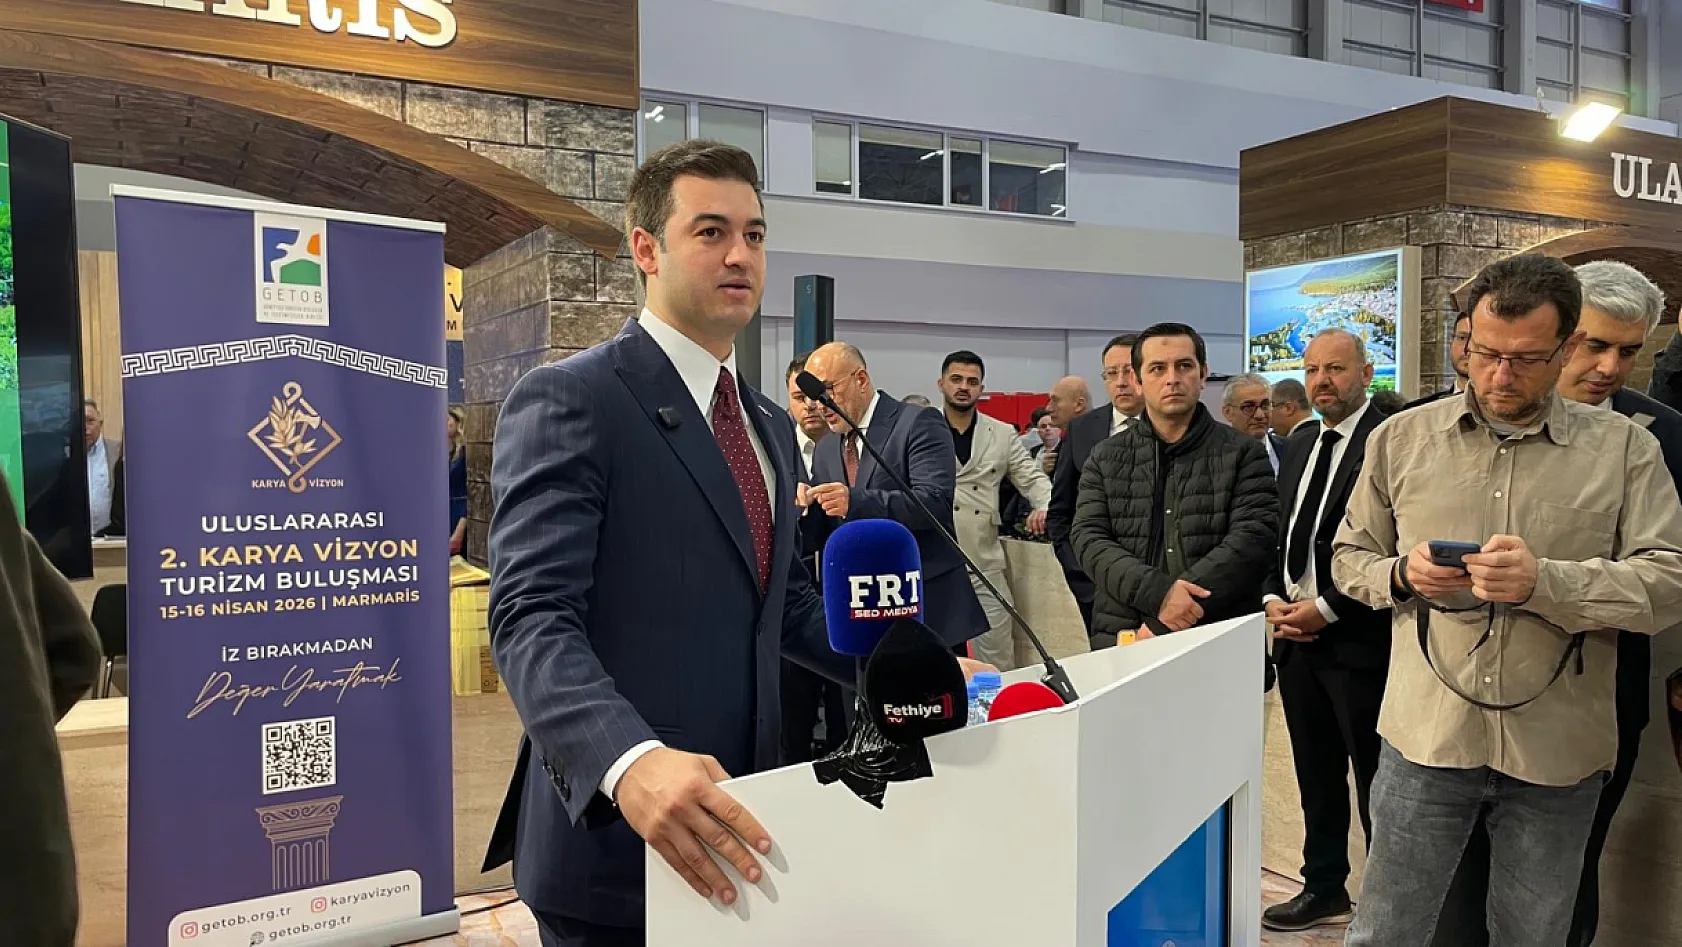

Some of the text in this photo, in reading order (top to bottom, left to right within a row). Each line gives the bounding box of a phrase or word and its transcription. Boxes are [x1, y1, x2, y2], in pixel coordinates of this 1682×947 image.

[262, 287, 323, 303] GETOB
[251, 477, 344, 489] KARYA VİZYON
[201, 511, 384, 533] ULUSLARARASI
[159, 536, 418, 570] 2. KARYA VİZYON
[159, 565, 419, 596] TURİZM BULUŞMASI
[848, 570, 921, 608] FRT
[159, 604, 206, 620] 15-16
[211, 599, 269, 616] NİSAN
[274, 597, 317, 612] 2026
[332, 588, 420, 608] MARMARİS
[854, 605, 918, 618] SED MEDYA
[221, 636, 374, 663] İZ BIRAKMADAN
[186, 671, 279, 719] Değer
[884, 703, 942, 719] Fethiye
[330, 883, 411, 906] karyavizyon
[201, 906, 291, 934] getob.org.tr
[268, 914, 352, 942] getob.org.tr
